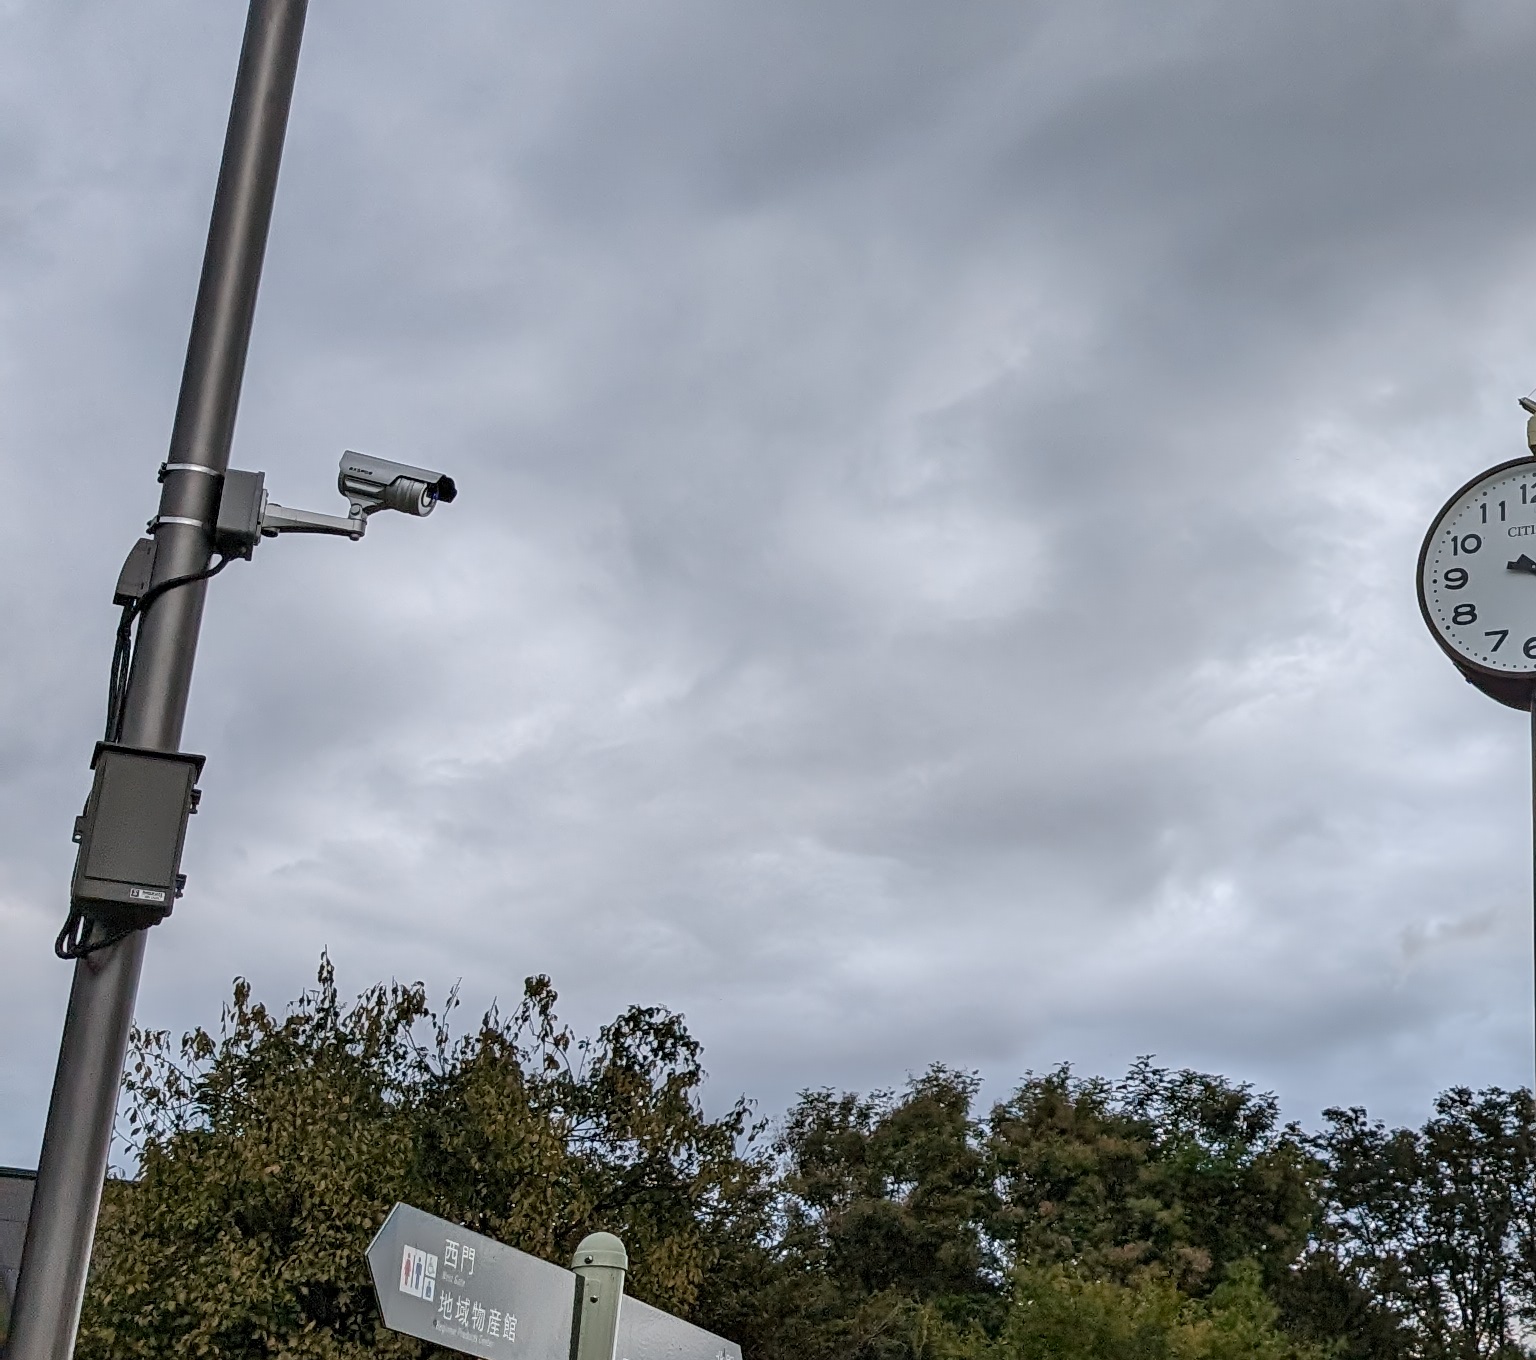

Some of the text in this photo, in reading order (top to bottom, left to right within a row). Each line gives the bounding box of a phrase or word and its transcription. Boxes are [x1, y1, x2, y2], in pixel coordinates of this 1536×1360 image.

[1479, 500, 1506, 524] 11
[1451, 533, 1483, 557] 10
[1443, 567, 1469, 591] 9
[1451, 603, 1478, 626] 8
[1484, 629, 1509, 653] 7
[443, 1239, 476, 1276] 西門
[437, 1289, 518, 1343] 地域物産館
